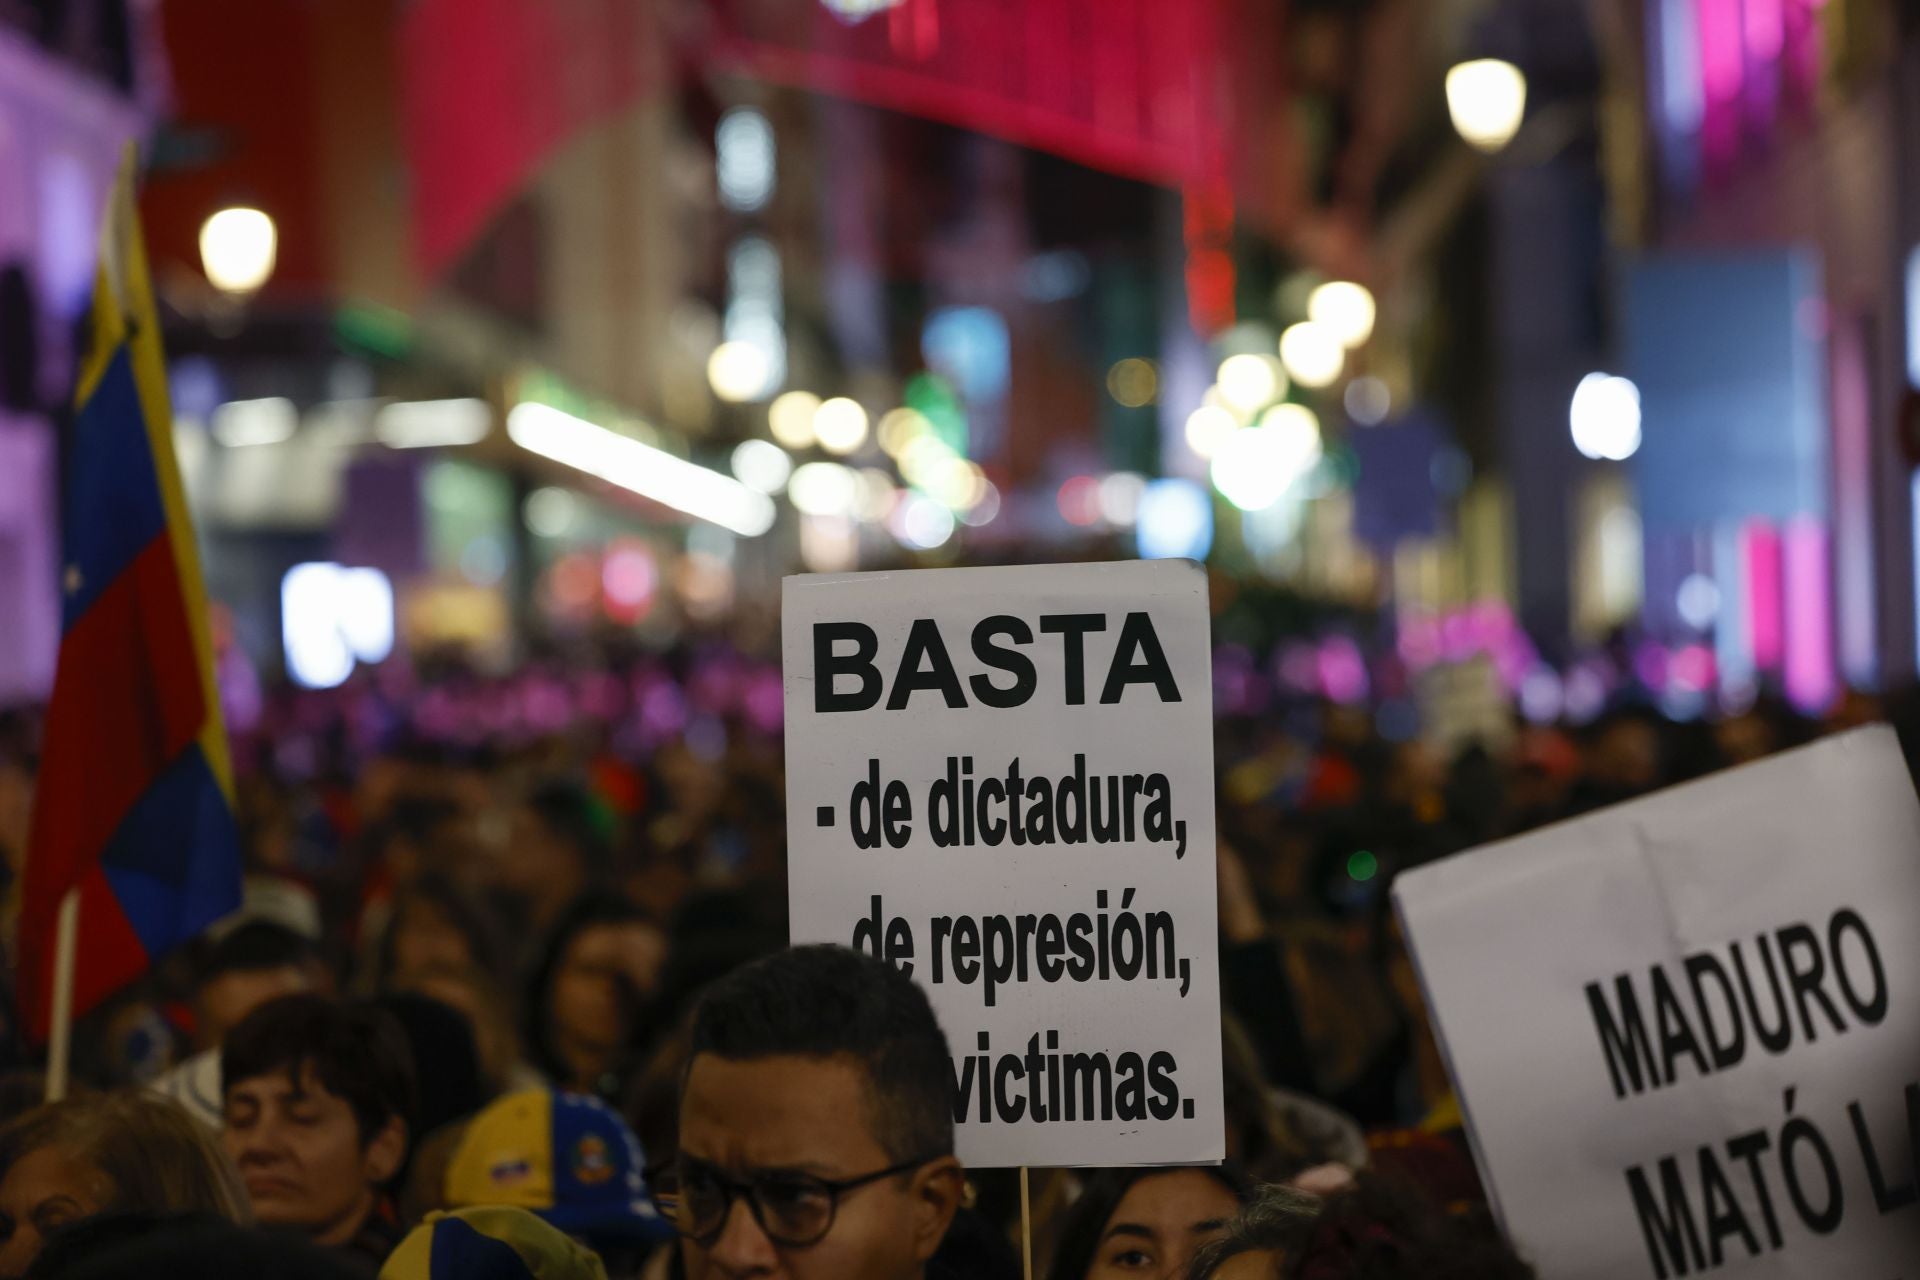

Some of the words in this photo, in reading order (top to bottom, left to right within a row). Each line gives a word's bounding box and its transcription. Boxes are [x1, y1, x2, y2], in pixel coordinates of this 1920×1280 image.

[812, 611, 1182, 713] BASTA
[850, 758, 912, 849] de
[928, 753, 1187, 860] dictadura,
[852, 894, 914, 981] de
[931, 887, 1191, 1007] represión,
[1585, 907, 1888, 1099] MADURO
[1625, 1084, 1844, 1280] MATÓ
